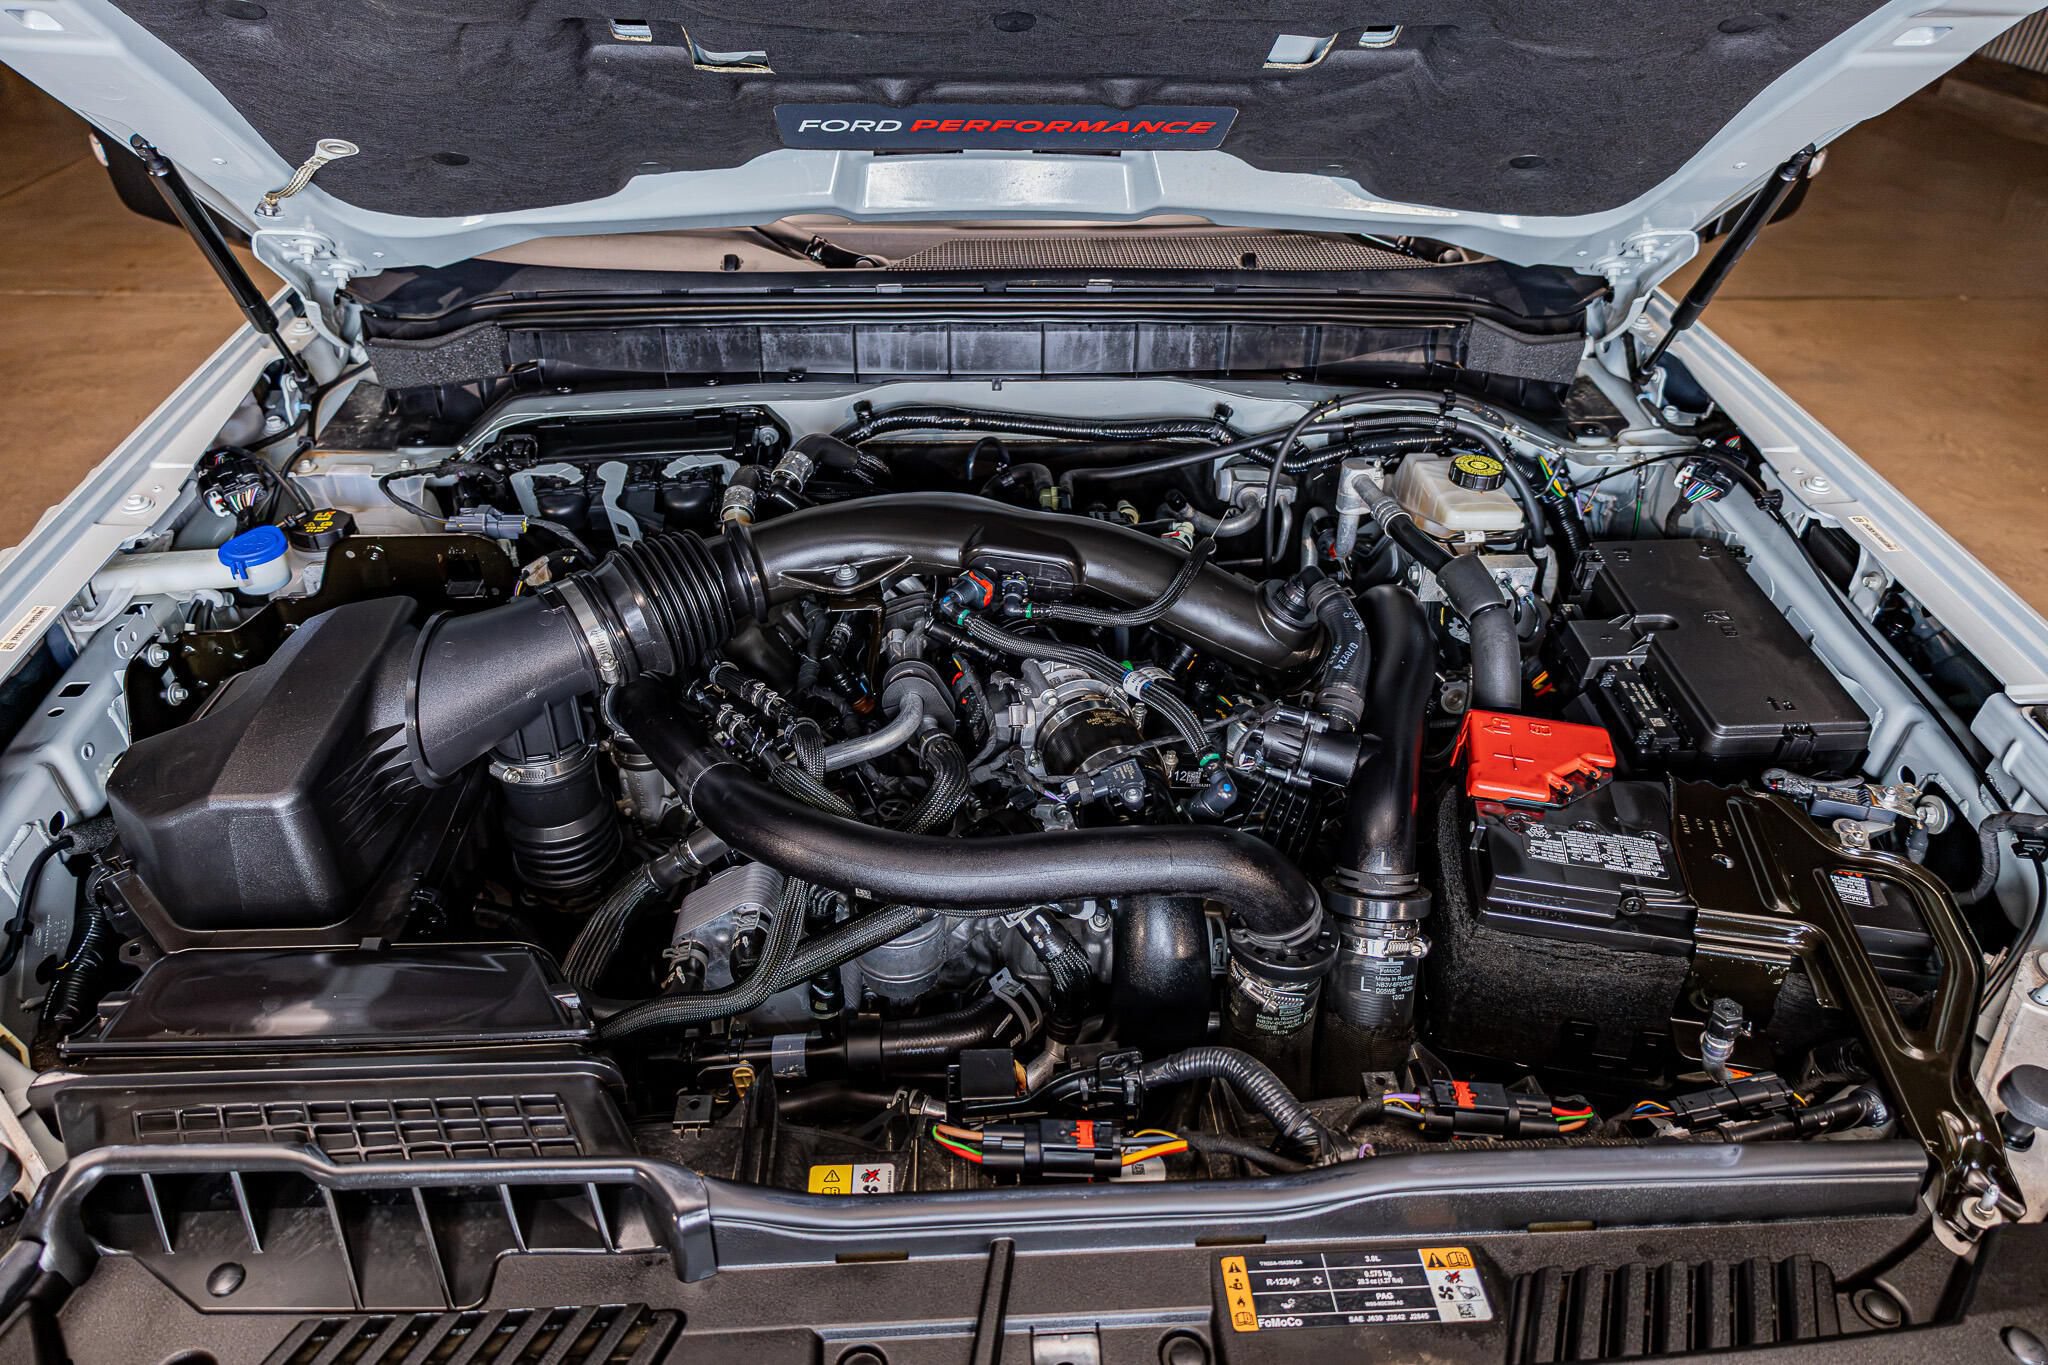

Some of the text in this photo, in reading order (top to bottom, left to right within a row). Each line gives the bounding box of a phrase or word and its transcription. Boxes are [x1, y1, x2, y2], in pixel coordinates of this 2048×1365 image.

[798, 119, 1217, 134] FORD PERFORMANCE
[1265, 1277, 1302, 1287] R-1234yf
[1375, 1292, 1395, 1300] PAG
[1257, 1317, 1304, 1328] FoMoCo
[1348, 1315, 1365, 1323] SAE
